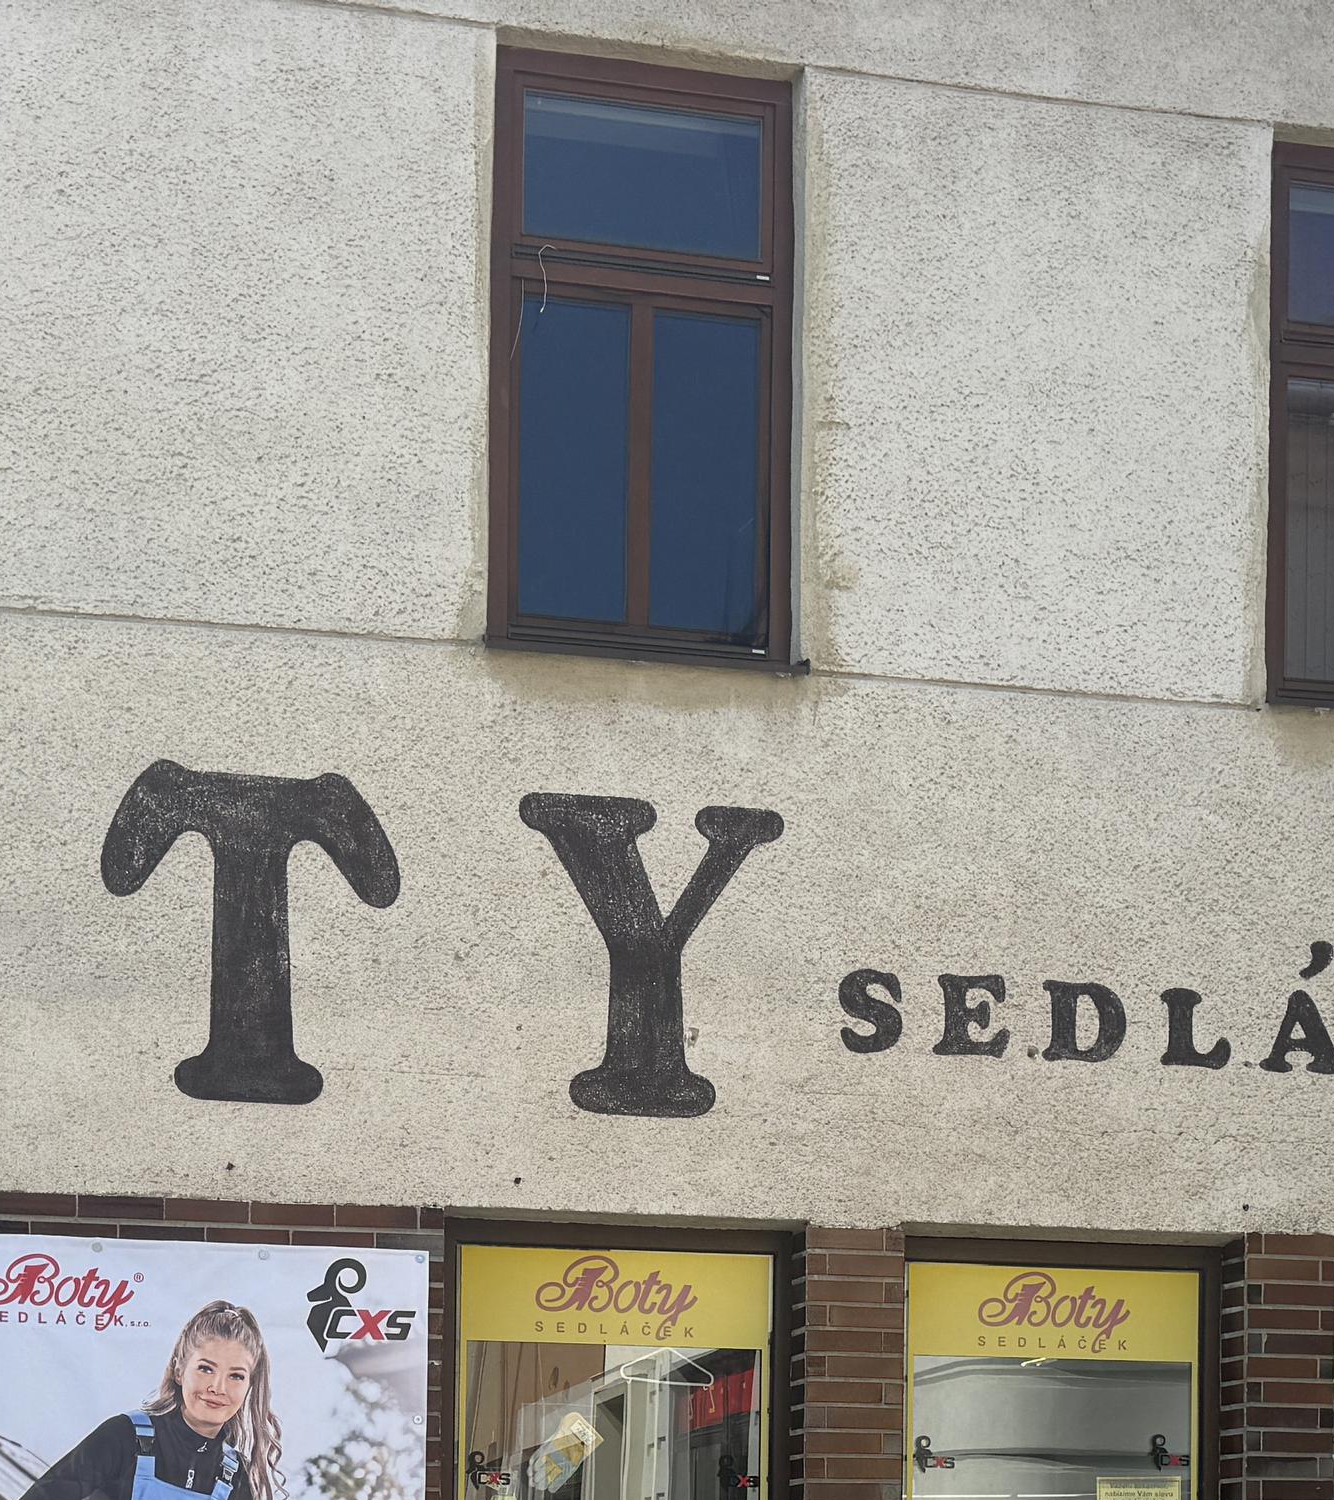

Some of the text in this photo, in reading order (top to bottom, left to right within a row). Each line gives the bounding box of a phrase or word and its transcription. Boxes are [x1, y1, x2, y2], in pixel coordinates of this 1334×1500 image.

[535, 1255, 698, 1341] Boty
[978, 1271, 1130, 1353] Boty
[325, 1309, 417, 1341] CXS
[535, 1321, 695, 1339] SEDLÁČEK
[978, 1335, 1128, 1351] SEDLÁČEK
